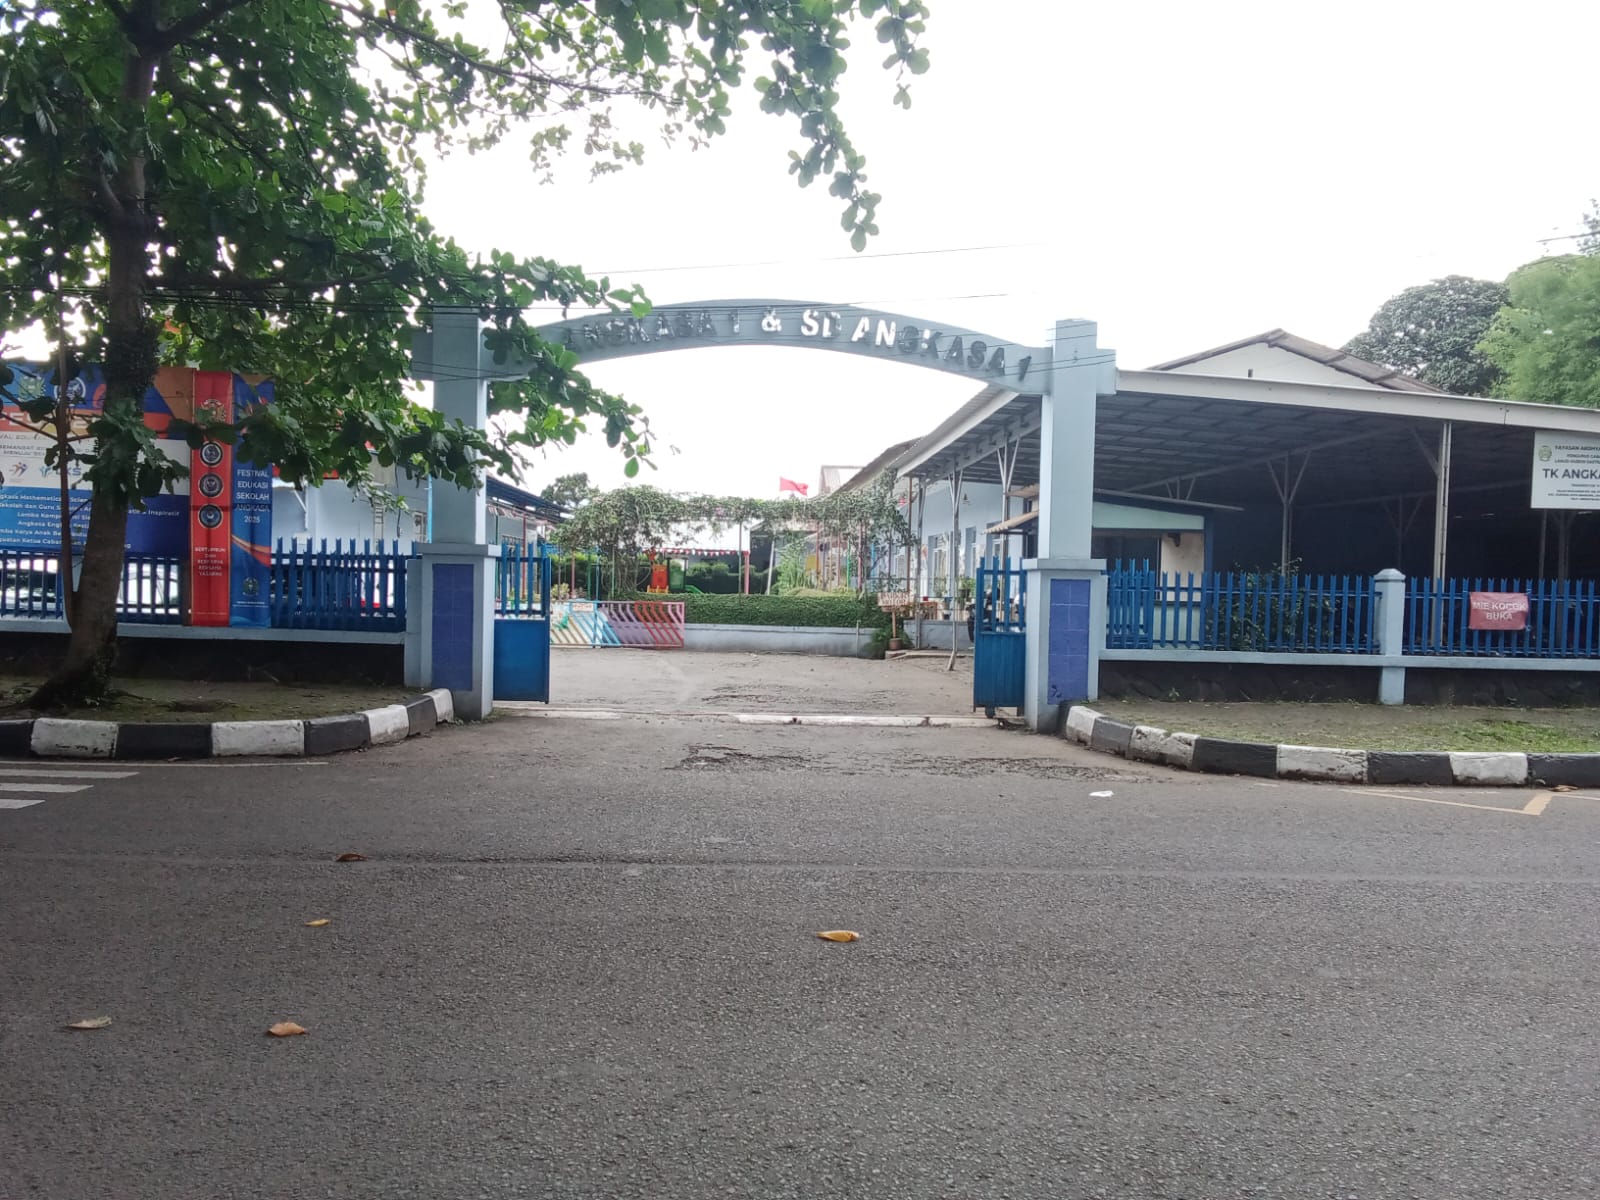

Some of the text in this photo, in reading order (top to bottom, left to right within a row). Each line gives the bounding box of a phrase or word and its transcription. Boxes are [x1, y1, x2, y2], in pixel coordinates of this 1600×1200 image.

[760, 308, 781, 333] &
[801, 310, 842, 338] SD
[851, 317, 1006, 376] ANGKASA
[1018, 356, 1031, 382] 1
[237, 469, 269, 478] FESTIVAL
[1542, 468, 1559, 479] TK
[237, 480, 268, 489] EDUKASI
[236, 492, 270, 500] SEKOLAH
[236, 503, 270, 512] ANGKASA
[1486, 611, 1513, 621] BUKA
